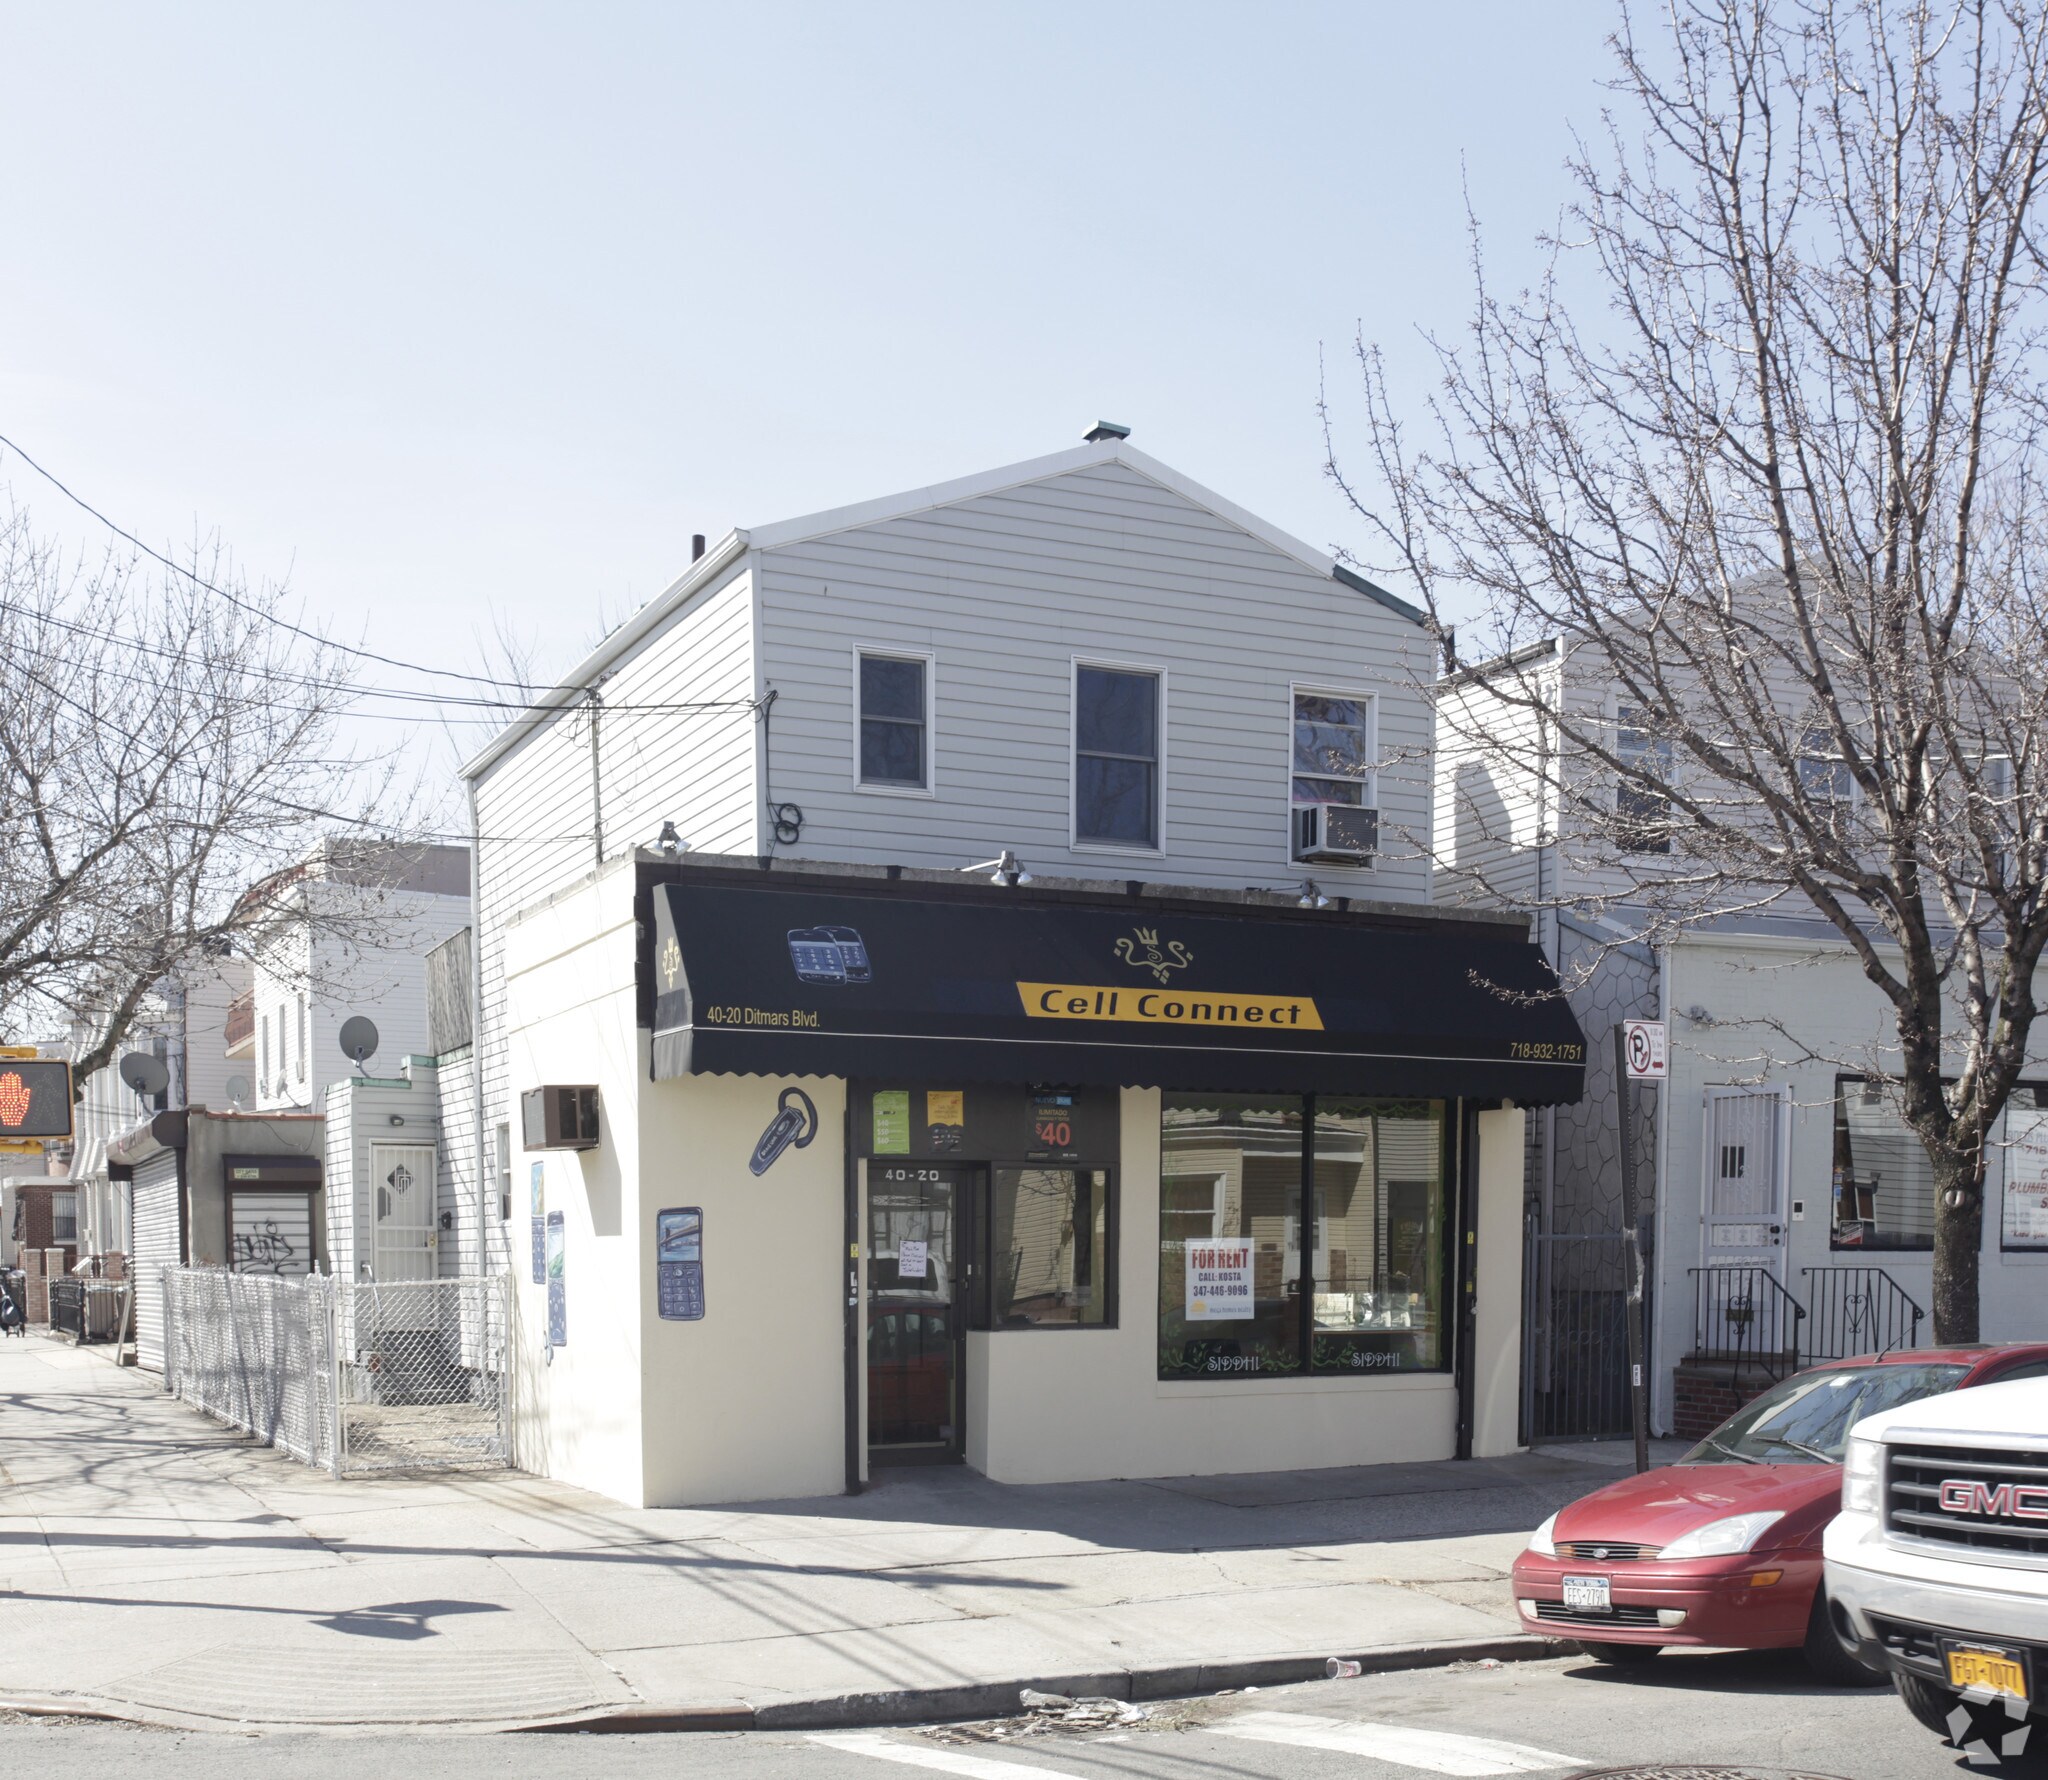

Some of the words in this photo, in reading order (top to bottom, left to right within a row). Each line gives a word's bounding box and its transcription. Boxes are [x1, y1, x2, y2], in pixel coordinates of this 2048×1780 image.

[707, 1006, 742, 1024] 40-20
[744, 1008, 789, 1026] Ditmars
[792, 1010, 820, 1027] Blvd.
[1039, 989, 1118, 1016] Cell
[1137, 994, 1302, 1024] Connect
[1510, 1042, 1582, 1060] 718-932-1751
[1035, 1122, 1071, 1147] $40
[885, 1169, 940, 1182] 40-20
[1191, 1248, 1215, 1269] FOR
[1217, 1247, 1249, 1269] RENT
[1218, 1272, 1242, 1281] KOSTA
[1939, 1479, 2048, 1519] GMC
